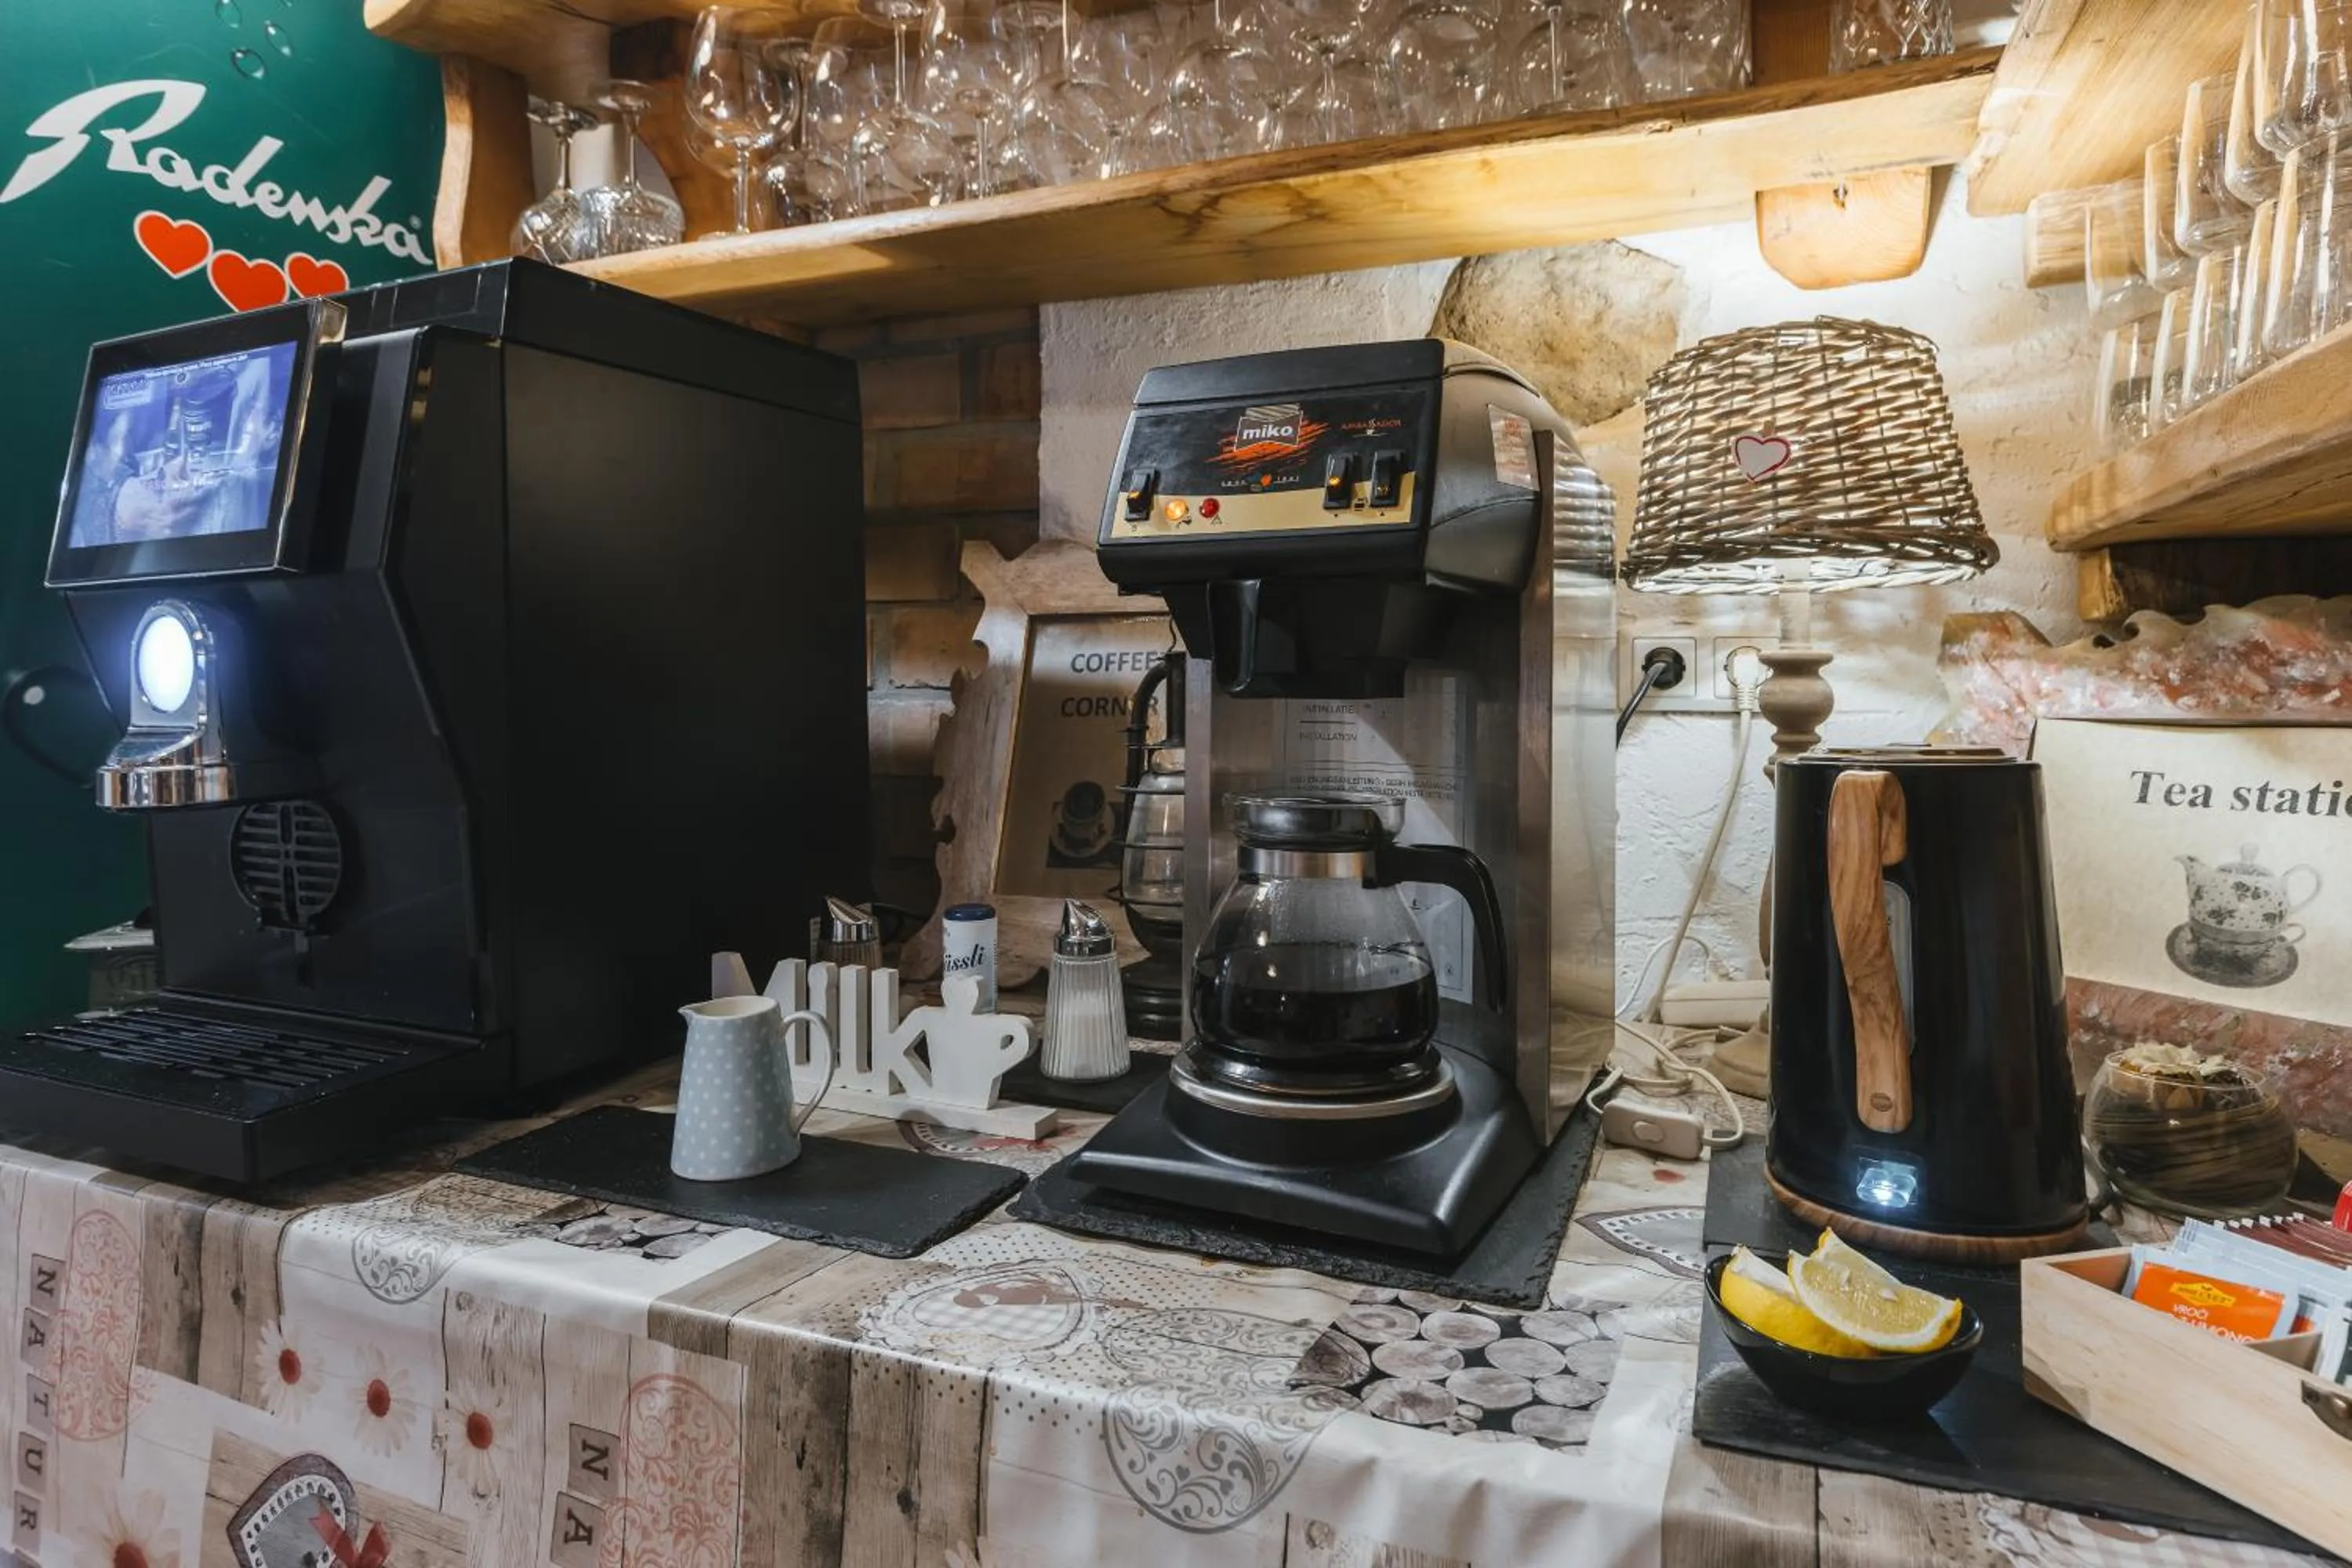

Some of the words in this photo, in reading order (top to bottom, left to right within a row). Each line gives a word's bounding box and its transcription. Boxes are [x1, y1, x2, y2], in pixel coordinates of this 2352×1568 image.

[0, 79, 434, 265] Radenska
[1242, 423, 1294, 441] miko
[1061, 695, 1159, 718] CORNR
[2130, 771, 2213, 808] Tea
